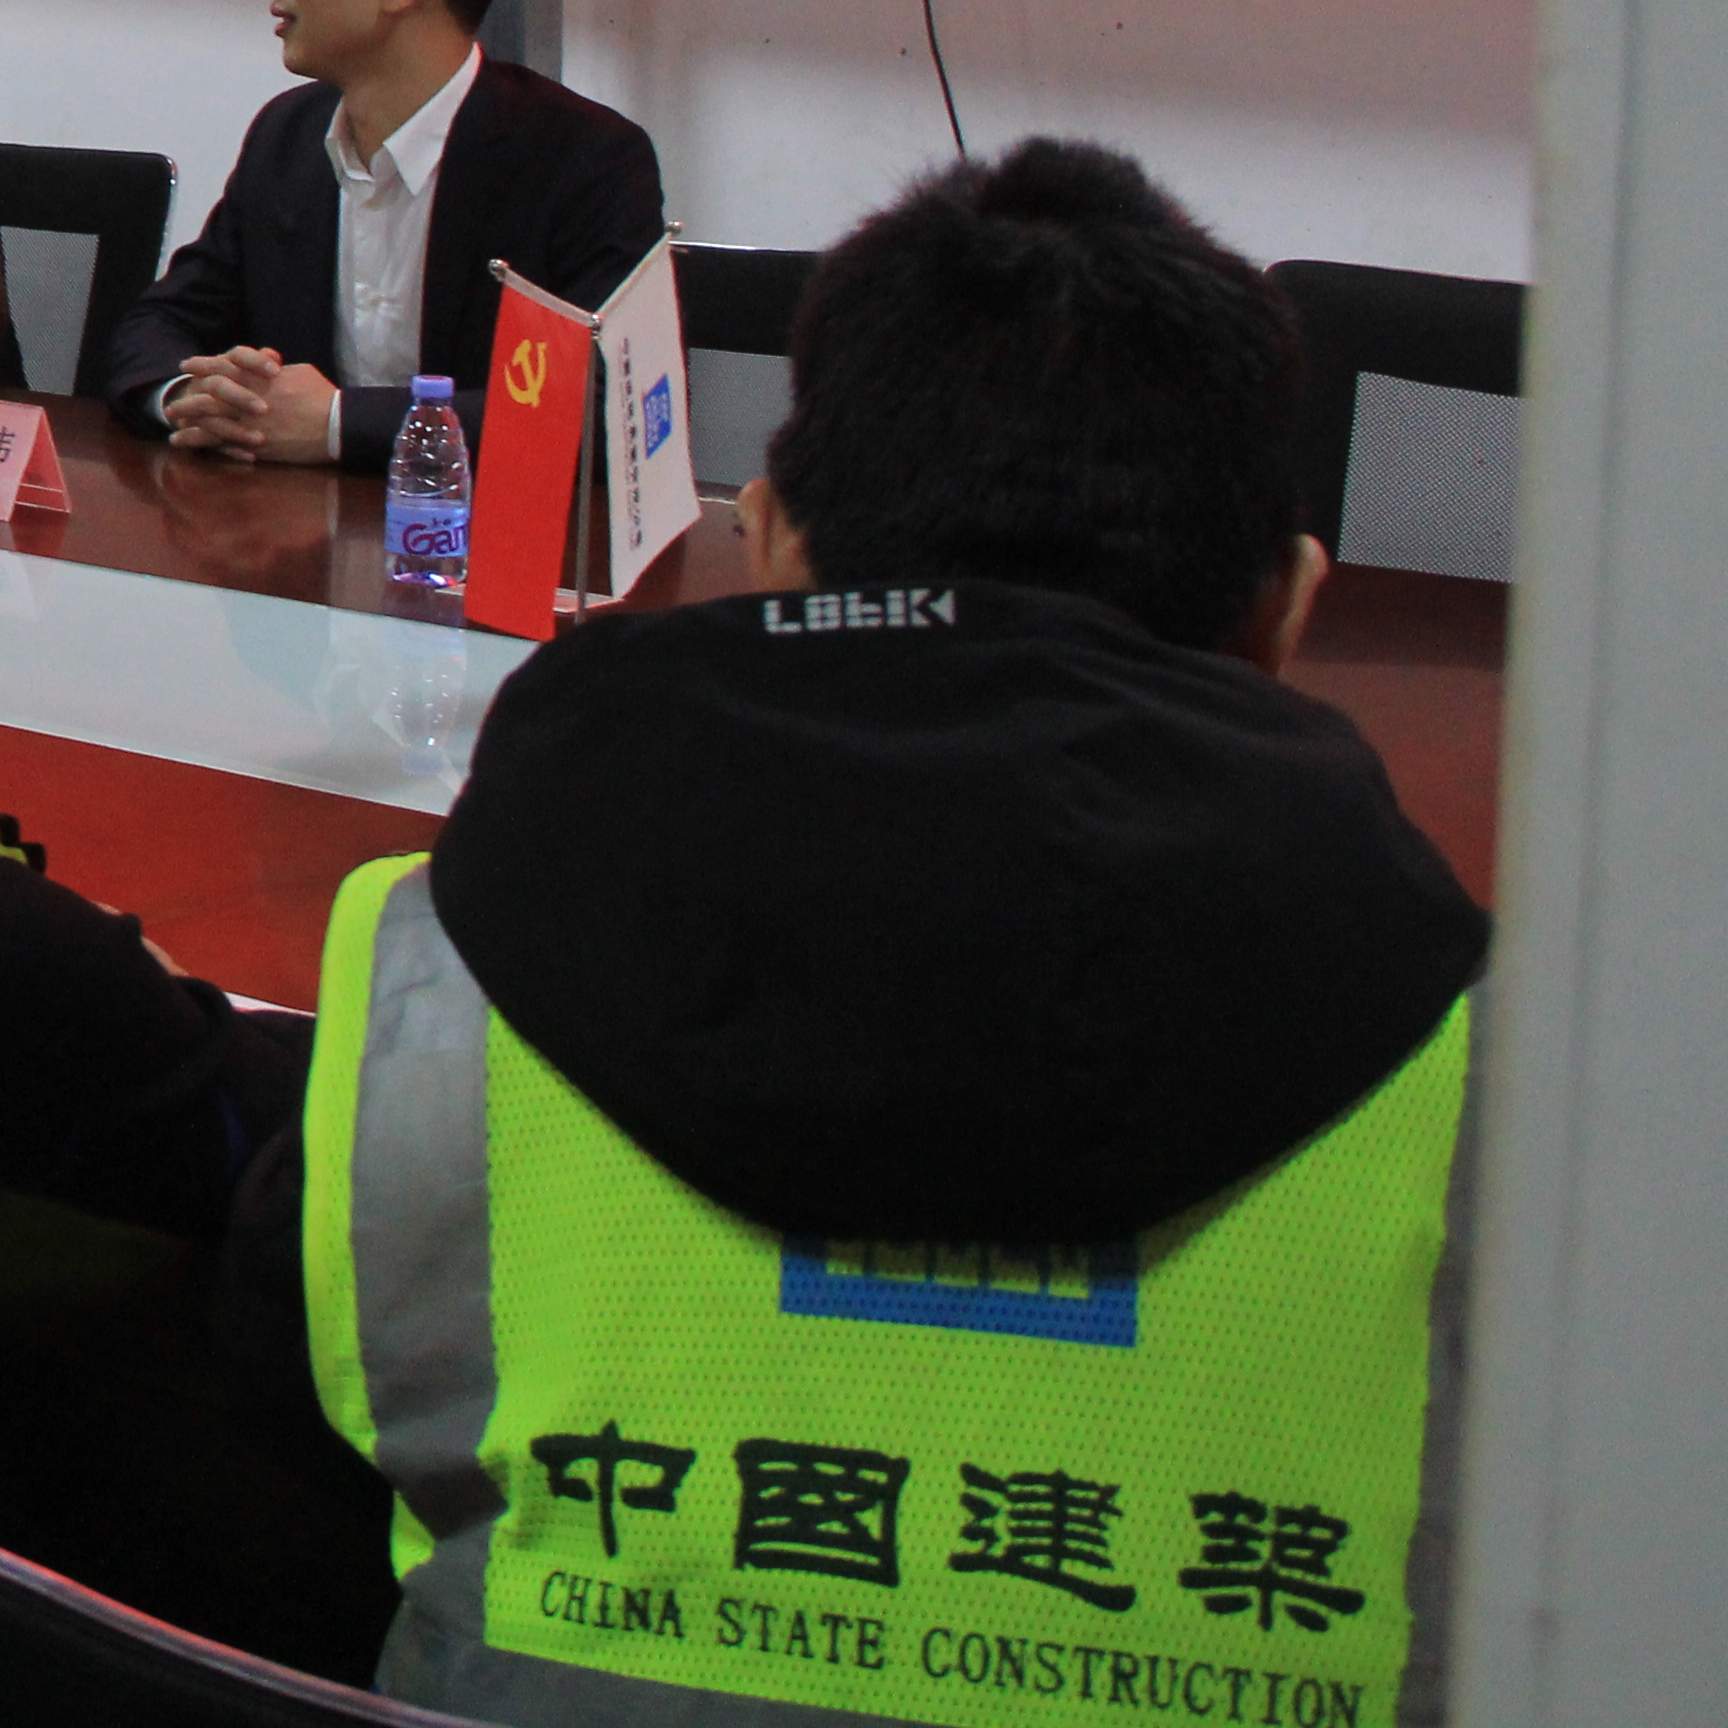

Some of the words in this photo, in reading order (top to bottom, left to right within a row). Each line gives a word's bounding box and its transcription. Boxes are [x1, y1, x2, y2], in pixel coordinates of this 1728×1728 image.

[530, 1420, 1366, 1633] 中國建築
[541, 1570, 686, 1641] CHINA
[716, 1597, 886, 1672] STATE
[921, 1626, 1365, 1728] CONSTRUCTION
